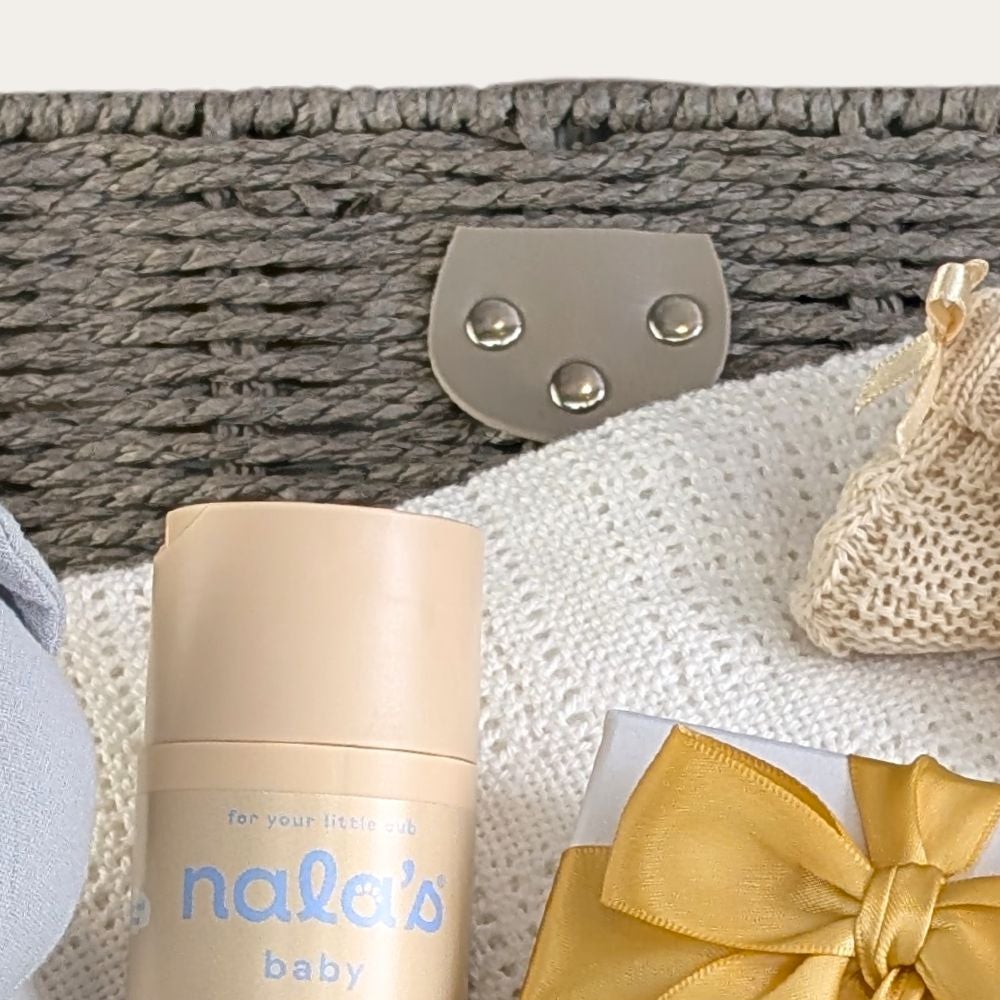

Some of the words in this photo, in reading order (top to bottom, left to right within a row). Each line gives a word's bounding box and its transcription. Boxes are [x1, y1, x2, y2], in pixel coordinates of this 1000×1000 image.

[228, 809, 259, 825] for
[267, 814, 315, 830] your
[324, 812, 376, 831] little
[384, 818, 417, 835] cub
[264, 950, 365, 991] baby
